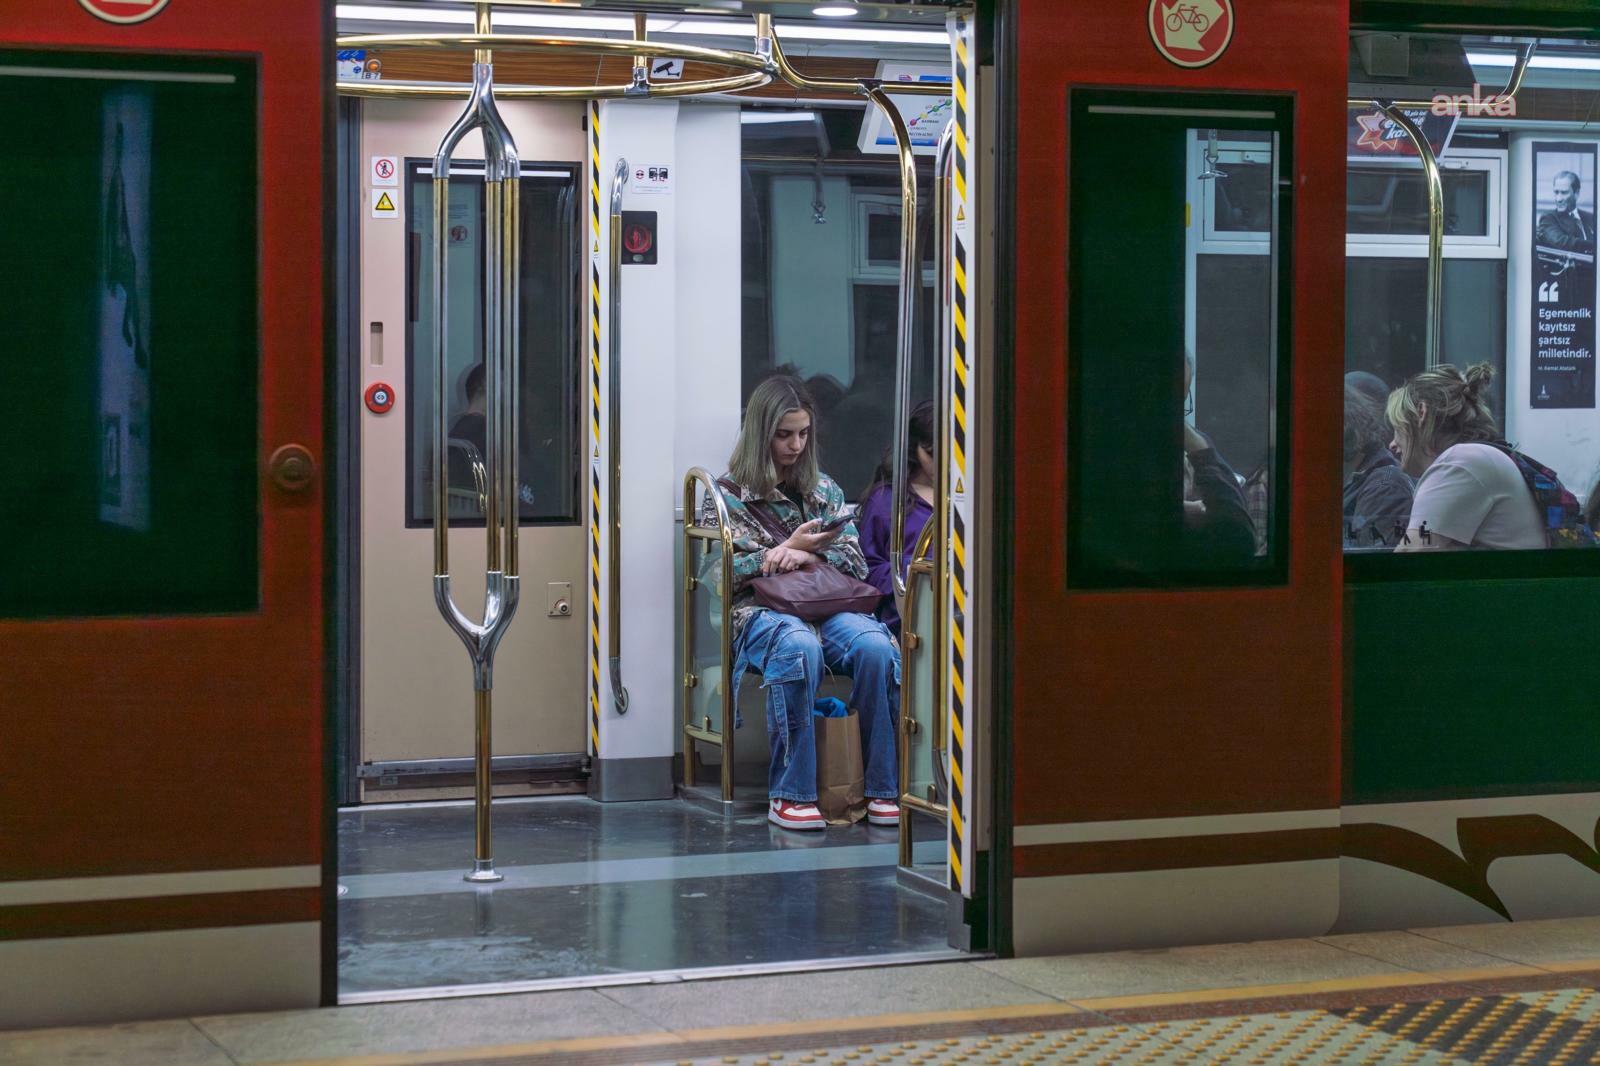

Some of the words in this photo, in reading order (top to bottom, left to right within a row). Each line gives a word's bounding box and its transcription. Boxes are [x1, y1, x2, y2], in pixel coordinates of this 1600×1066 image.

[1538, 308, 1592, 319] Egemenlik
[1538, 321, 1576, 333] kayıtsız
[1538, 335, 1571, 347] şartsız
[1538, 348, 1592, 359] milletindir.
